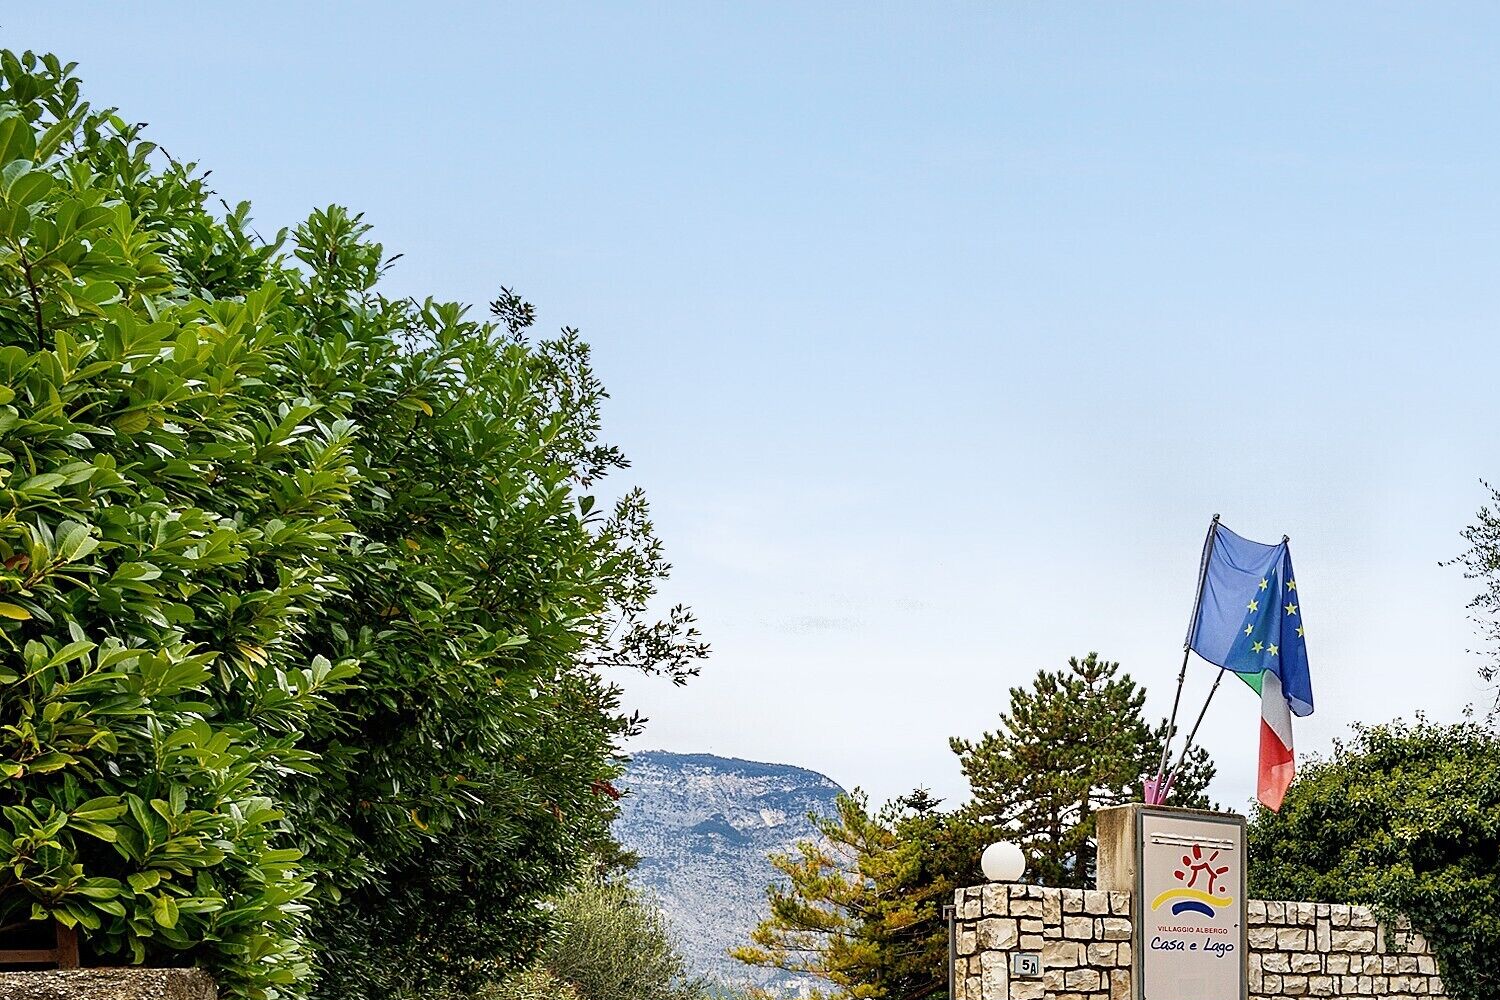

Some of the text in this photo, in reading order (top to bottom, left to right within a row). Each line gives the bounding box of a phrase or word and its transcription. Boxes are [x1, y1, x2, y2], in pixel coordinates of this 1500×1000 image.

[1157, 925, 1228, 935] VILLAGGIO ALBERGO
[1150, 936, 1235, 958] Casa e Lago
